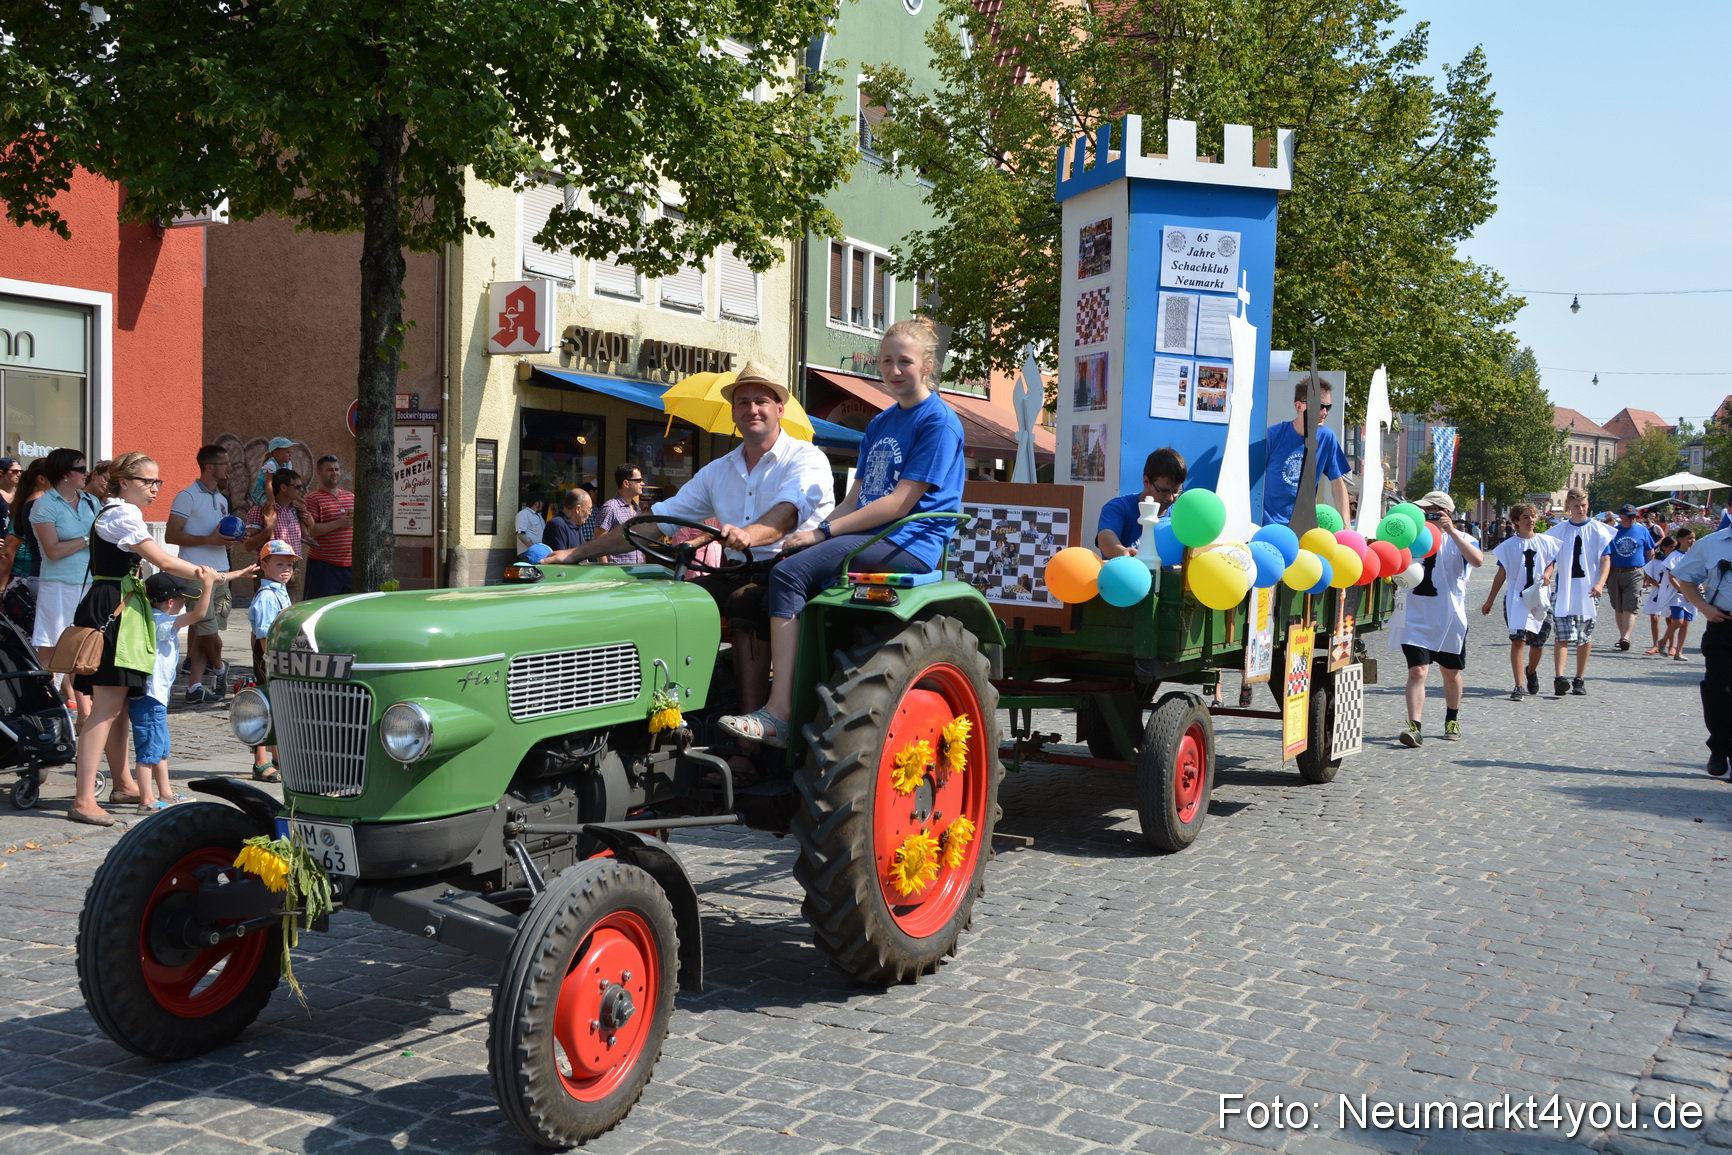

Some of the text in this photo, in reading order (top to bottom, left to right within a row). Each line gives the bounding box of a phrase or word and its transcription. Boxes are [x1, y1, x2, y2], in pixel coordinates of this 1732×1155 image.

[1196, 232, 1209, 243] 65
[1186, 246, 1216, 259] Jahre
[1171, 260, 1229, 275] Schachklub
[1175, 275, 1225, 289] Neumarkt
[566, 325, 738, 374] STADT APOTHEKE
[397, 411, 438, 421] Bockwirtsgasse
[394, 460, 432, 481] VENEZIA
[269, 649, 352, 679] FENDT
[322, 850, 347, 873] 63
